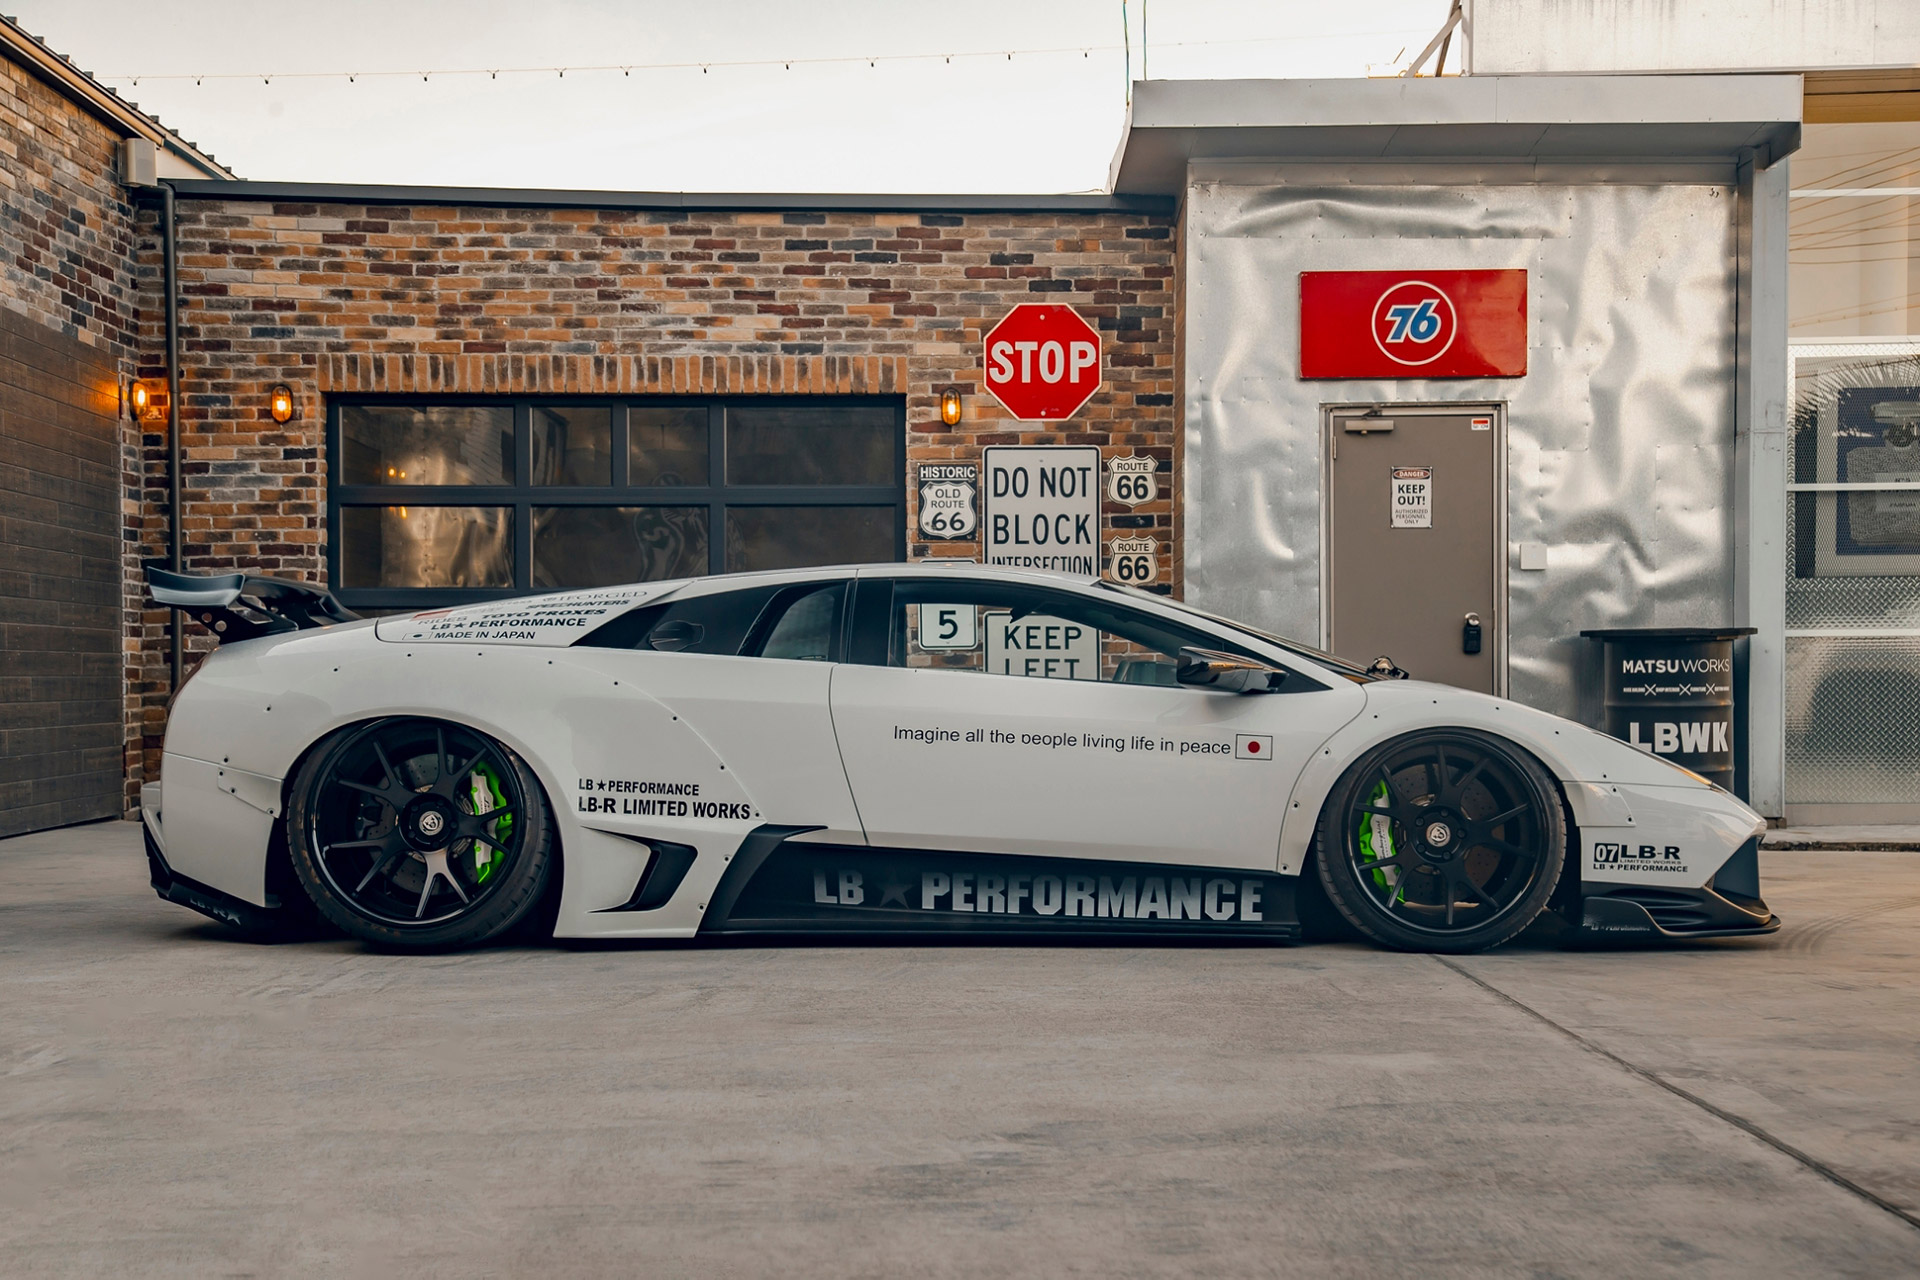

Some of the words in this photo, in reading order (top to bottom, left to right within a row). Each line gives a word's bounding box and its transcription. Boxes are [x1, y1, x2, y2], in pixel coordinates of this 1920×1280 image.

[1385, 298, 1442, 343] 76
[989, 340, 1097, 384] STOP
[920, 466, 976, 479] HISTORIC
[1117, 462, 1149, 472] ROUTE
[993, 466, 1029, 498] DO
[1040, 466, 1092, 498] NOT
[1116, 475, 1149, 500] 66
[1397, 484, 1425, 494] KEEP
[935, 488, 962, 499] OLD
[1397, 496, 1426, 505] OUT!
[931, 500, 965, 509] ROUTE
[932, 511, 965, 532] 66
[992, 513, 1092, 545] BLOCK
[1117, 542, 1150, 552] ROUTE
[1117, 555, 1150, 580] 66
[482, 611, 530, 619] TOYO
[534, 608, 608, 616] PROXES
[431, 622, 452, 631] LB
[469, 617, 587, 629] PERFORMANCE
[938, 610, 959, 640] 5
[434, 631, 473, 639] MADE
[475, 631, 489, 639] IN
[491, 631, 536, 640] JAPAN
[1004, 625, 1082, 650] KEEP
[1622, 659, 1680, 674] MATSU
[1681, 658, 1730, 673] WORKS
[894, 725, 960, 745] Imagine
[965, 728, 984, 743] all
[989, 729, 1016, 744] the
[1082, 733, 1125, 753] living
[1131, 735, 1155, 751] life
[1160, 737, 1174, 752] in
[1180, 741, 1231, 756] peace
[1629, 721, 1729, 753] LBWK
[578, 778, 594, 791] LB
[608, 780, 700, 796] PERFORMANCE
[578, 796, 617, 814] LB-R
[623, 798, 688, 817] LIMITED
[693, 801, 751, 820] WORKS
[1594, 843, 1619, 862] 07
[1620, 844, 1681, 860] LB-R
[1617, 864, 1689, 873] PERFORMANCE
[813, 869, 864, 905] LB
[921, 871, 1264, 922] PERFORMANCE
